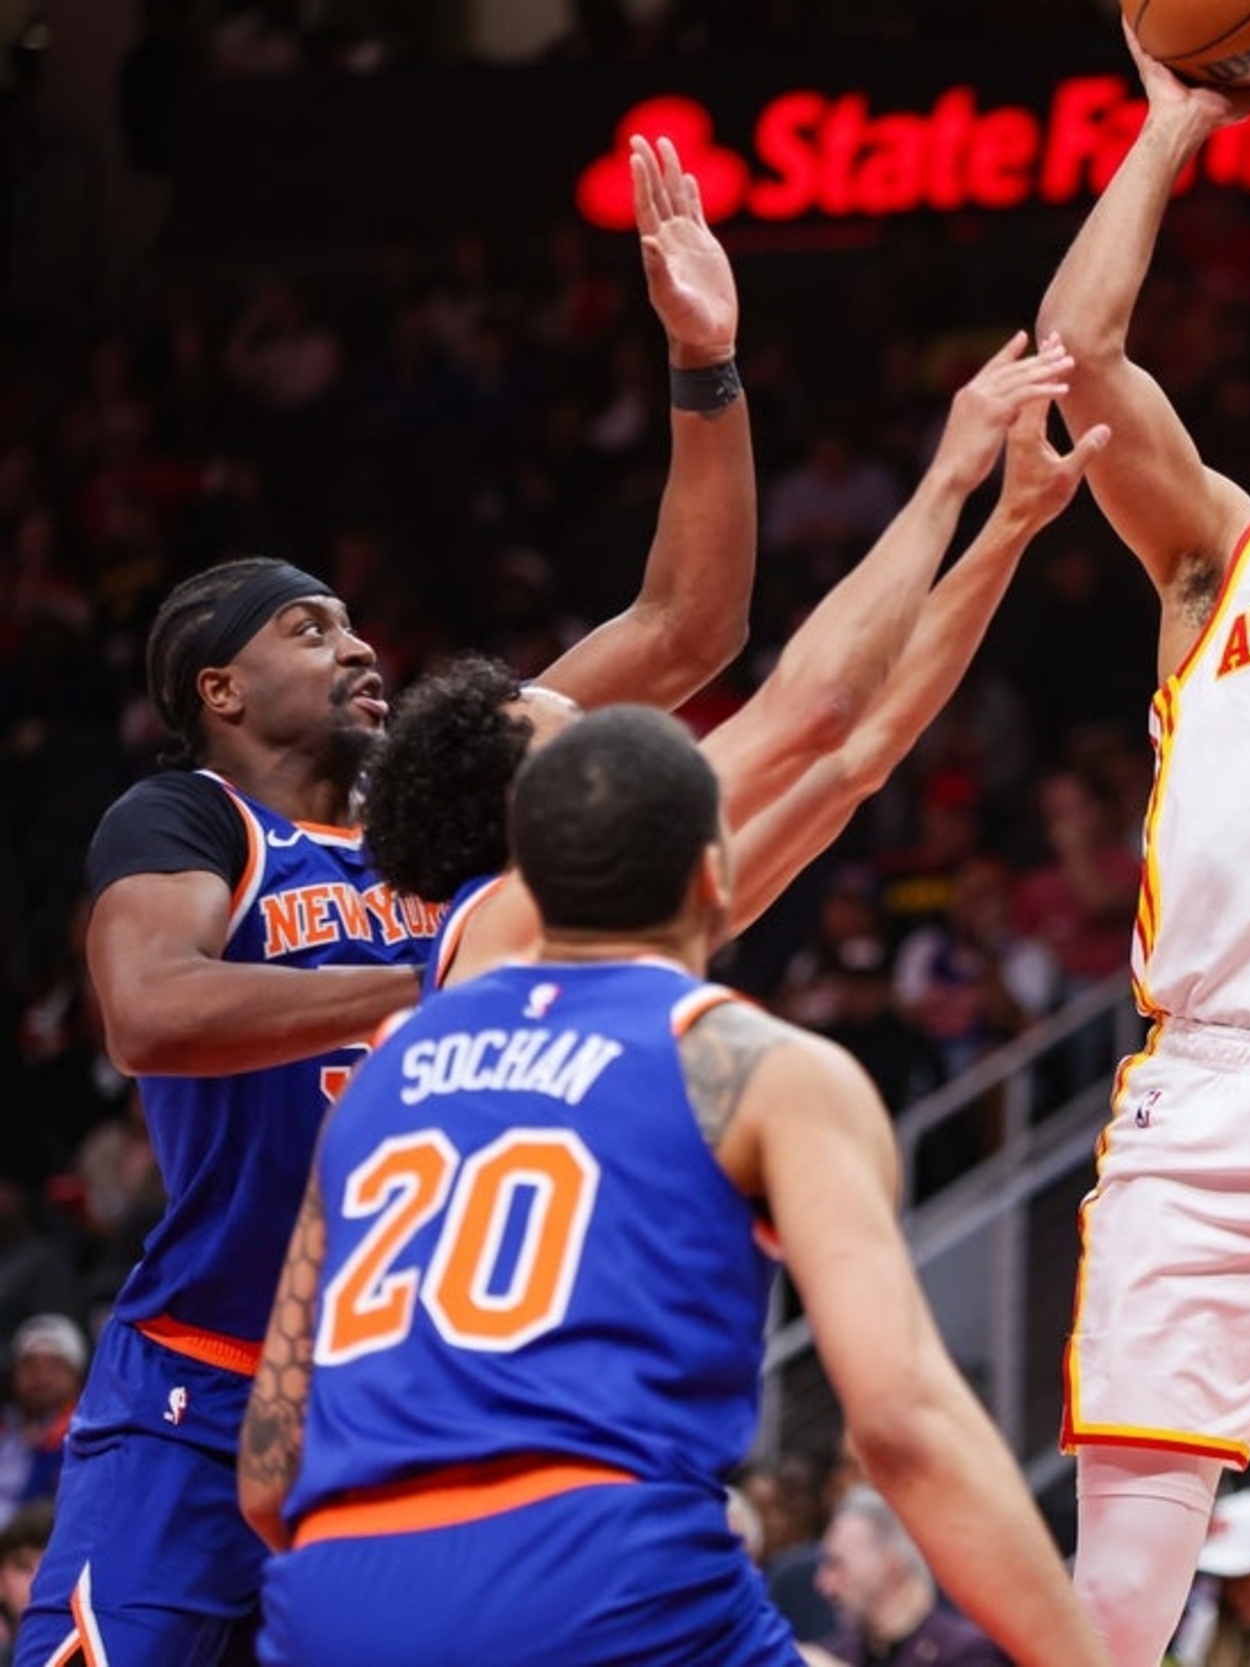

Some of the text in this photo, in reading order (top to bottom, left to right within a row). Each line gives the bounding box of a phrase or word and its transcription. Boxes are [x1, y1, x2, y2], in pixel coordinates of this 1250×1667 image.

[750, 87, 1037, 220] State
[260, 882, 372, 959] NEW
[401, 1028, 622, 1105] SOCHAN
[313, 1127, 601, 1366] 20
